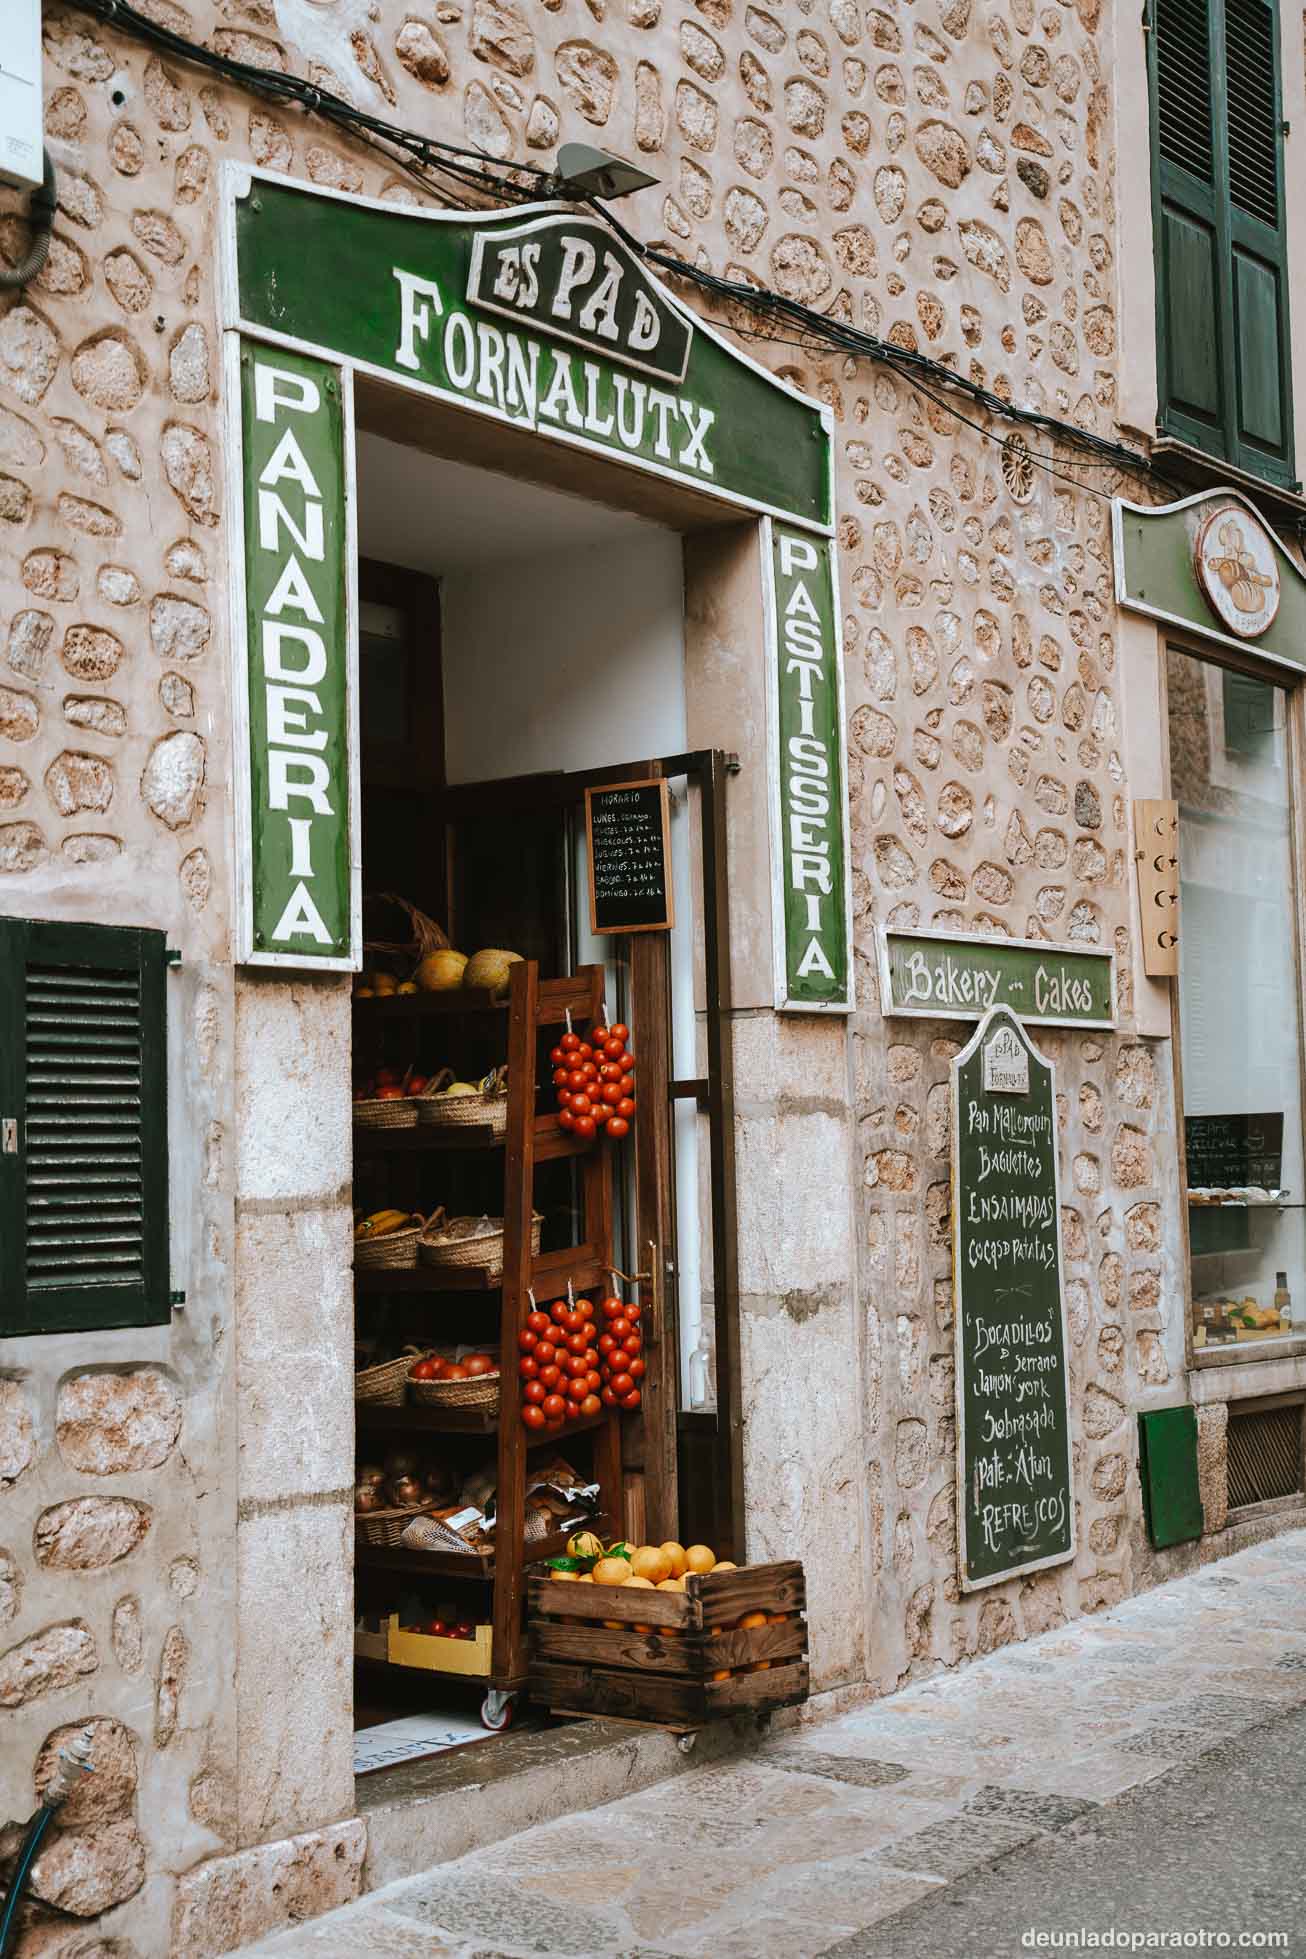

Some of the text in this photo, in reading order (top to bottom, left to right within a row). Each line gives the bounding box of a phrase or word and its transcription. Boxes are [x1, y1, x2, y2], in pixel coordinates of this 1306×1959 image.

[493, 242, 541, 308] ES
[551, 236, 624, 342] PA
[393, 266, 716, 475] FORNALUTX
[254, 362, 335, 945] PANADERIA
[780, 534, 836, 980] PASTISSERIA
[905, 951, 1092, 1014] Bakery Cakes
[968, 1100, 989, 1135] Pan
[981, 1402, 1057, 1442] Sobrasada
[982, 1487, 1065, 1553] REFRESCOS
